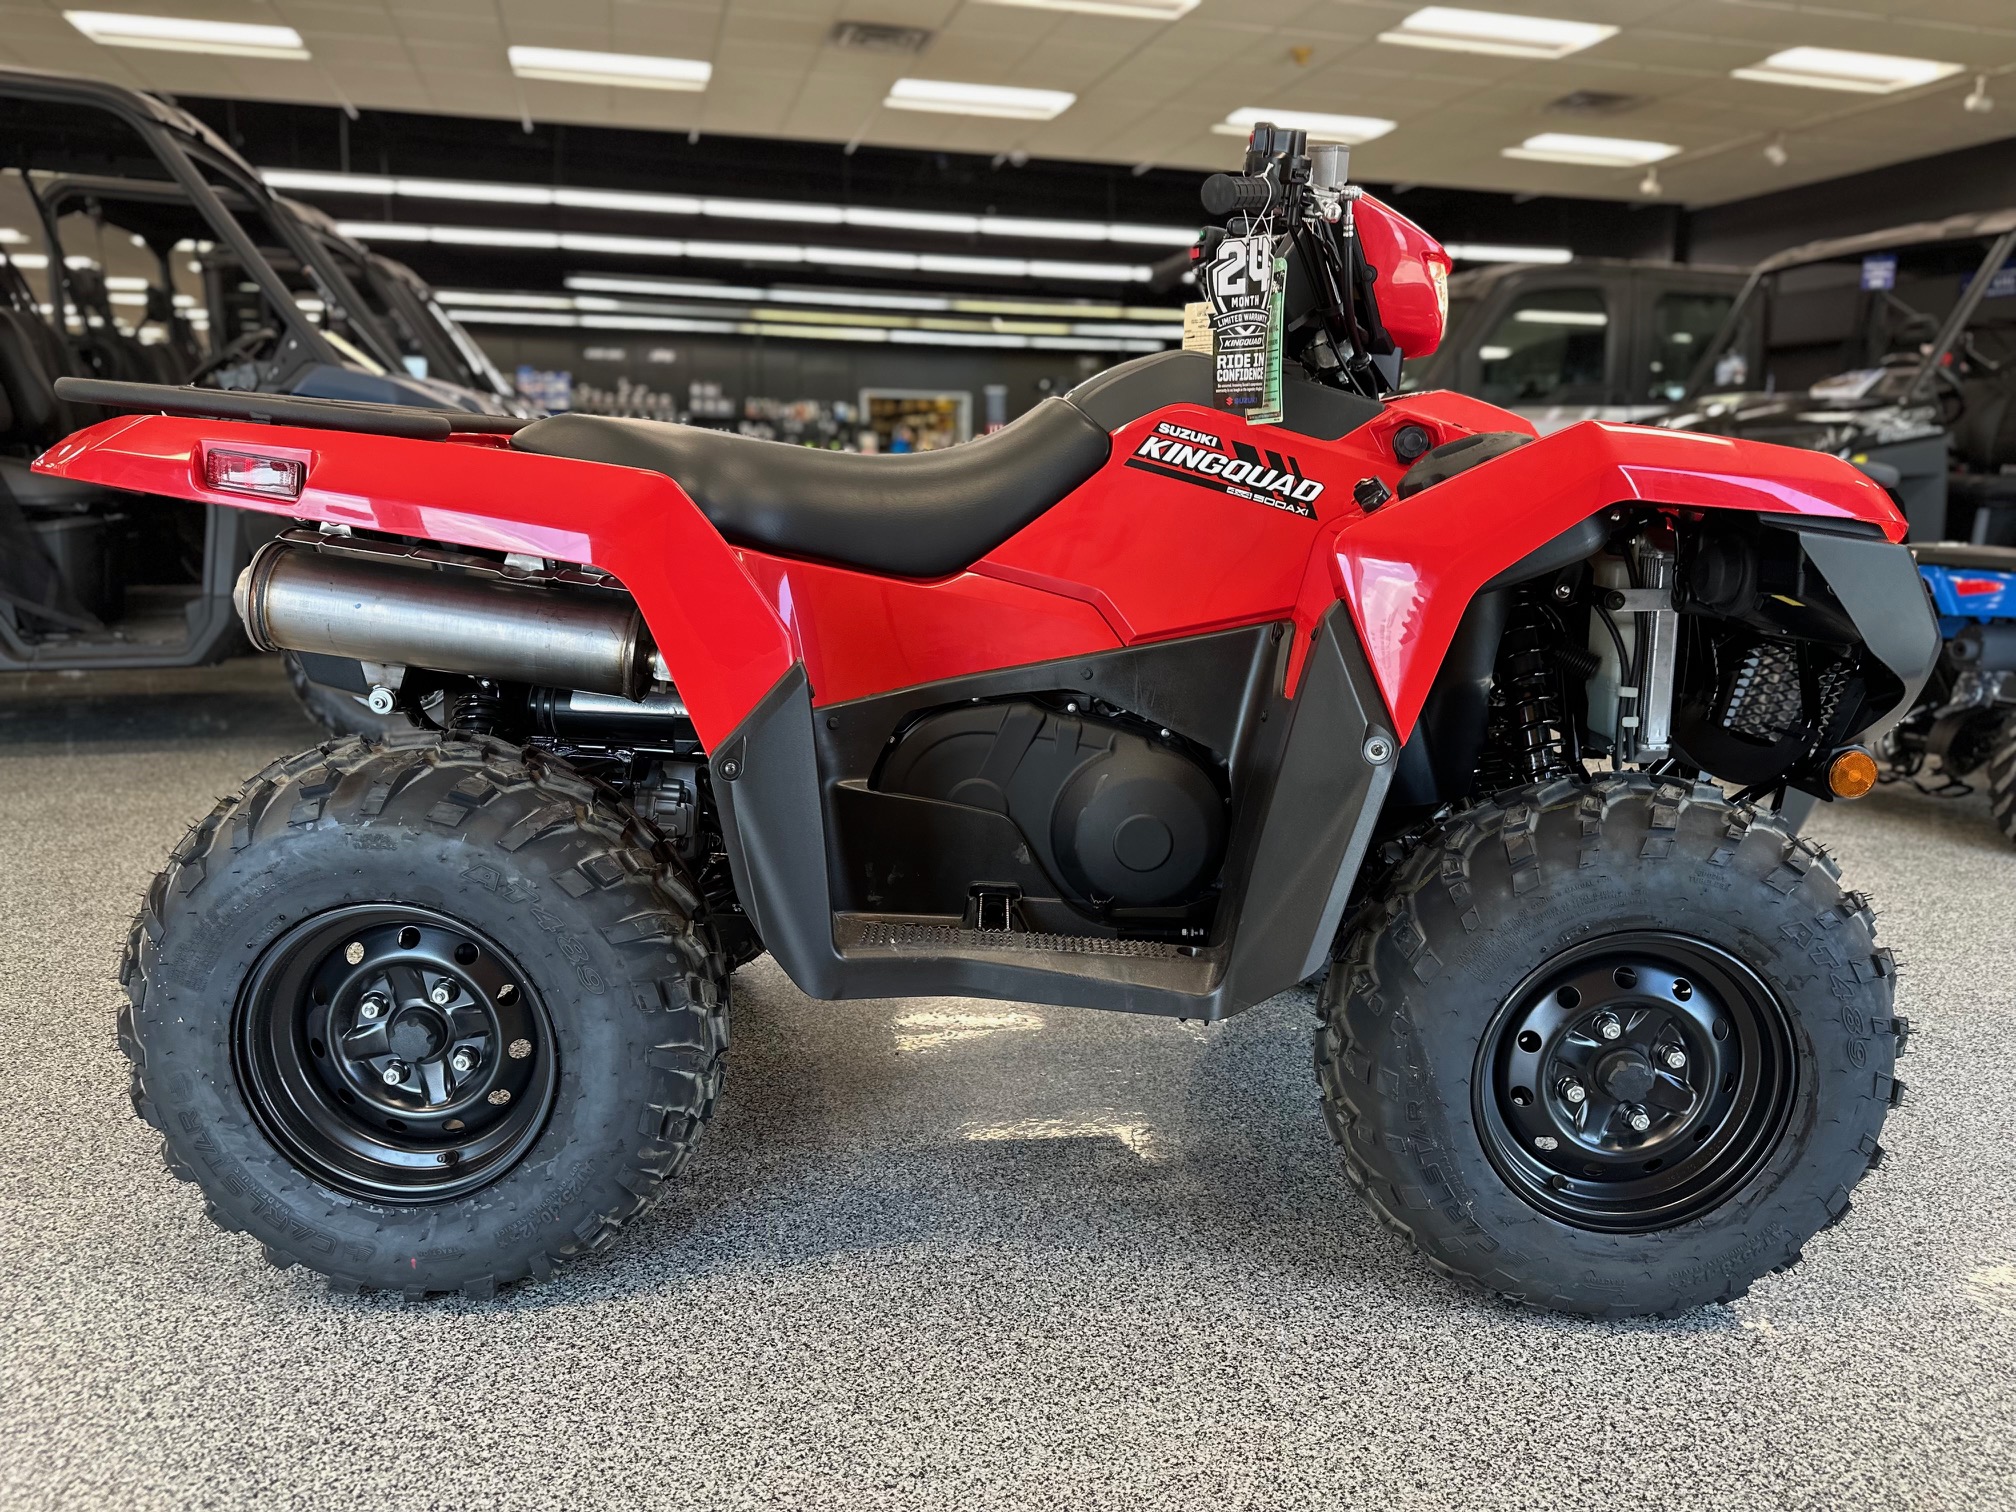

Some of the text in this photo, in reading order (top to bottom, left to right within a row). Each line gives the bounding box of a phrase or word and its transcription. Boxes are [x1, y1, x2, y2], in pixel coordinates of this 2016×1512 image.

[1218, 238, 1270, 295] 24
[1231, 295, 1260, 308] MONTH
[1218, 314, 1243, 328] LIMITED
[1243, 311, 1268, 323] WARRANTY
[1224, 337, 1262, 348] KINGQUAD
[1216, 352, 1265, 370] RIDE IN
[1216, 367, 1264, 383] CONFIDENCE
[1233, 396, 1258, 405] SUZUKI
[1158, 422, 1218, 448] SUZUKI
[1138, 436, 1326, 502] KINGQUAD
[527, 1190, 558, 1219] HIGHWAY
